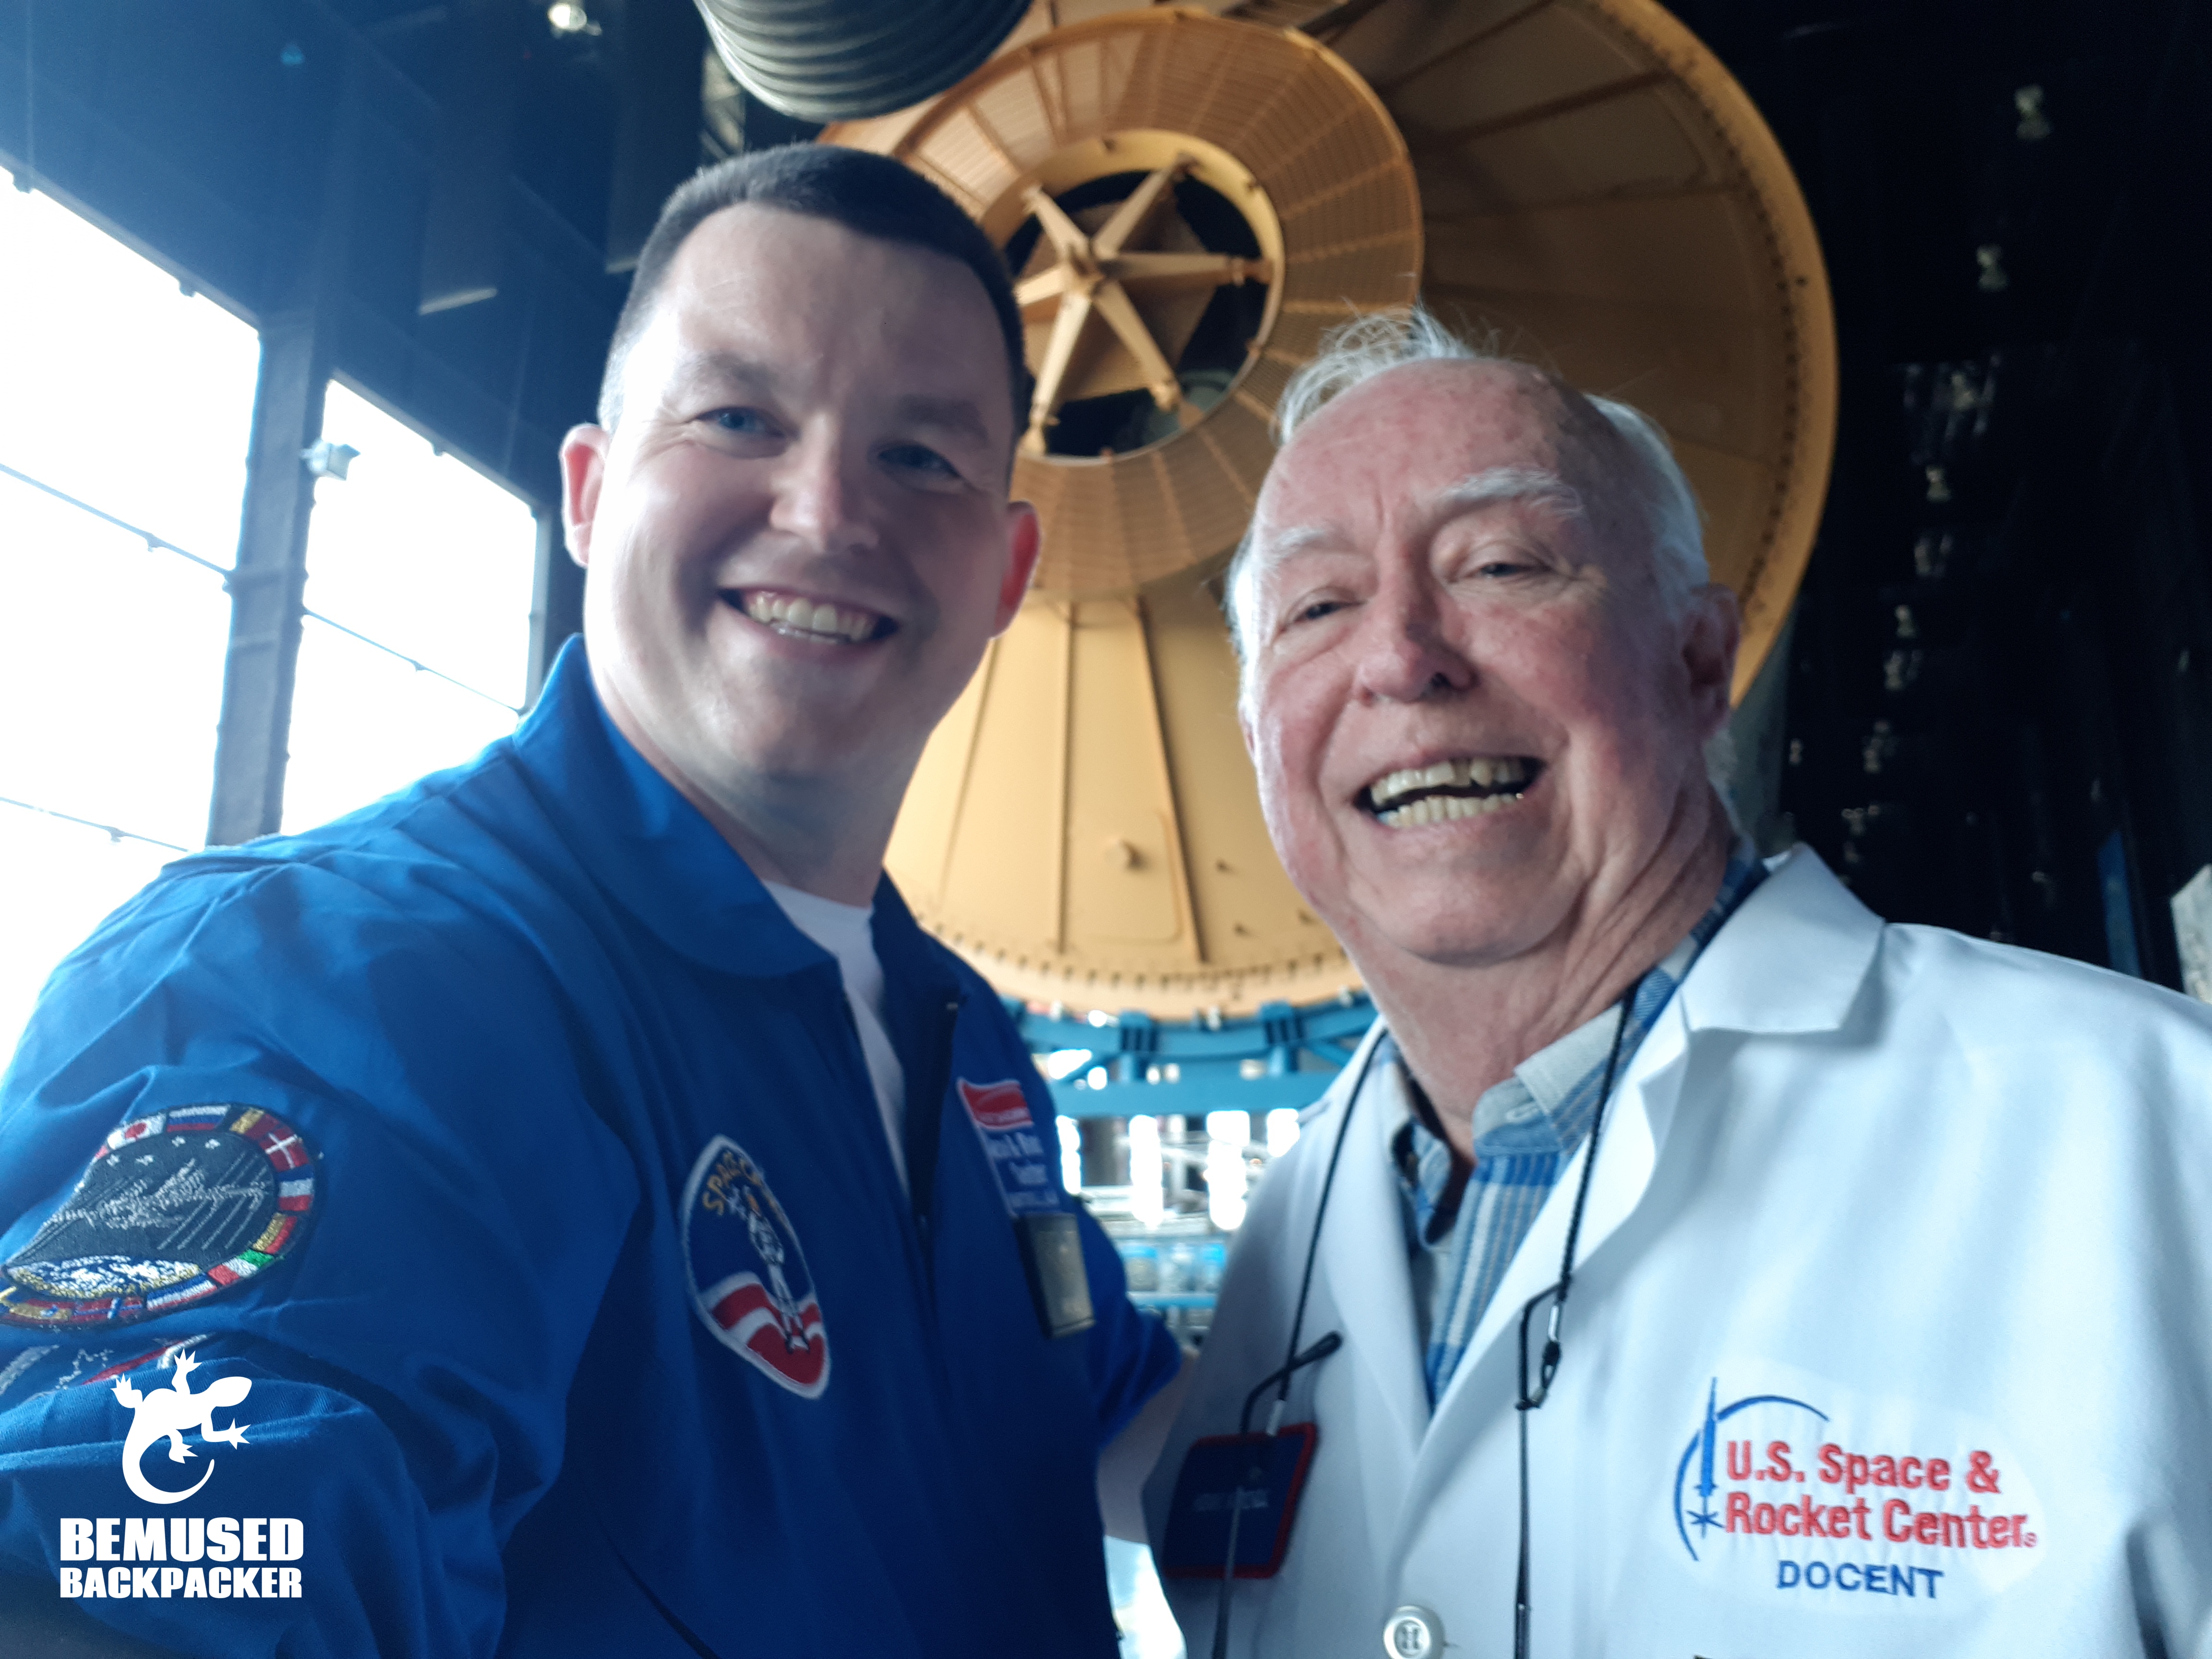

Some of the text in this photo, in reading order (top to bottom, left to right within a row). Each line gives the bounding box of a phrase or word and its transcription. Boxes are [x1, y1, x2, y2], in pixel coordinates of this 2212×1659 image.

[1726, 1440, 2002, 1494] U.S. Space &
[1726, 1491, 1873, 1540] Rocket
[1777, 1560, 1945, 1599] DOCENT
